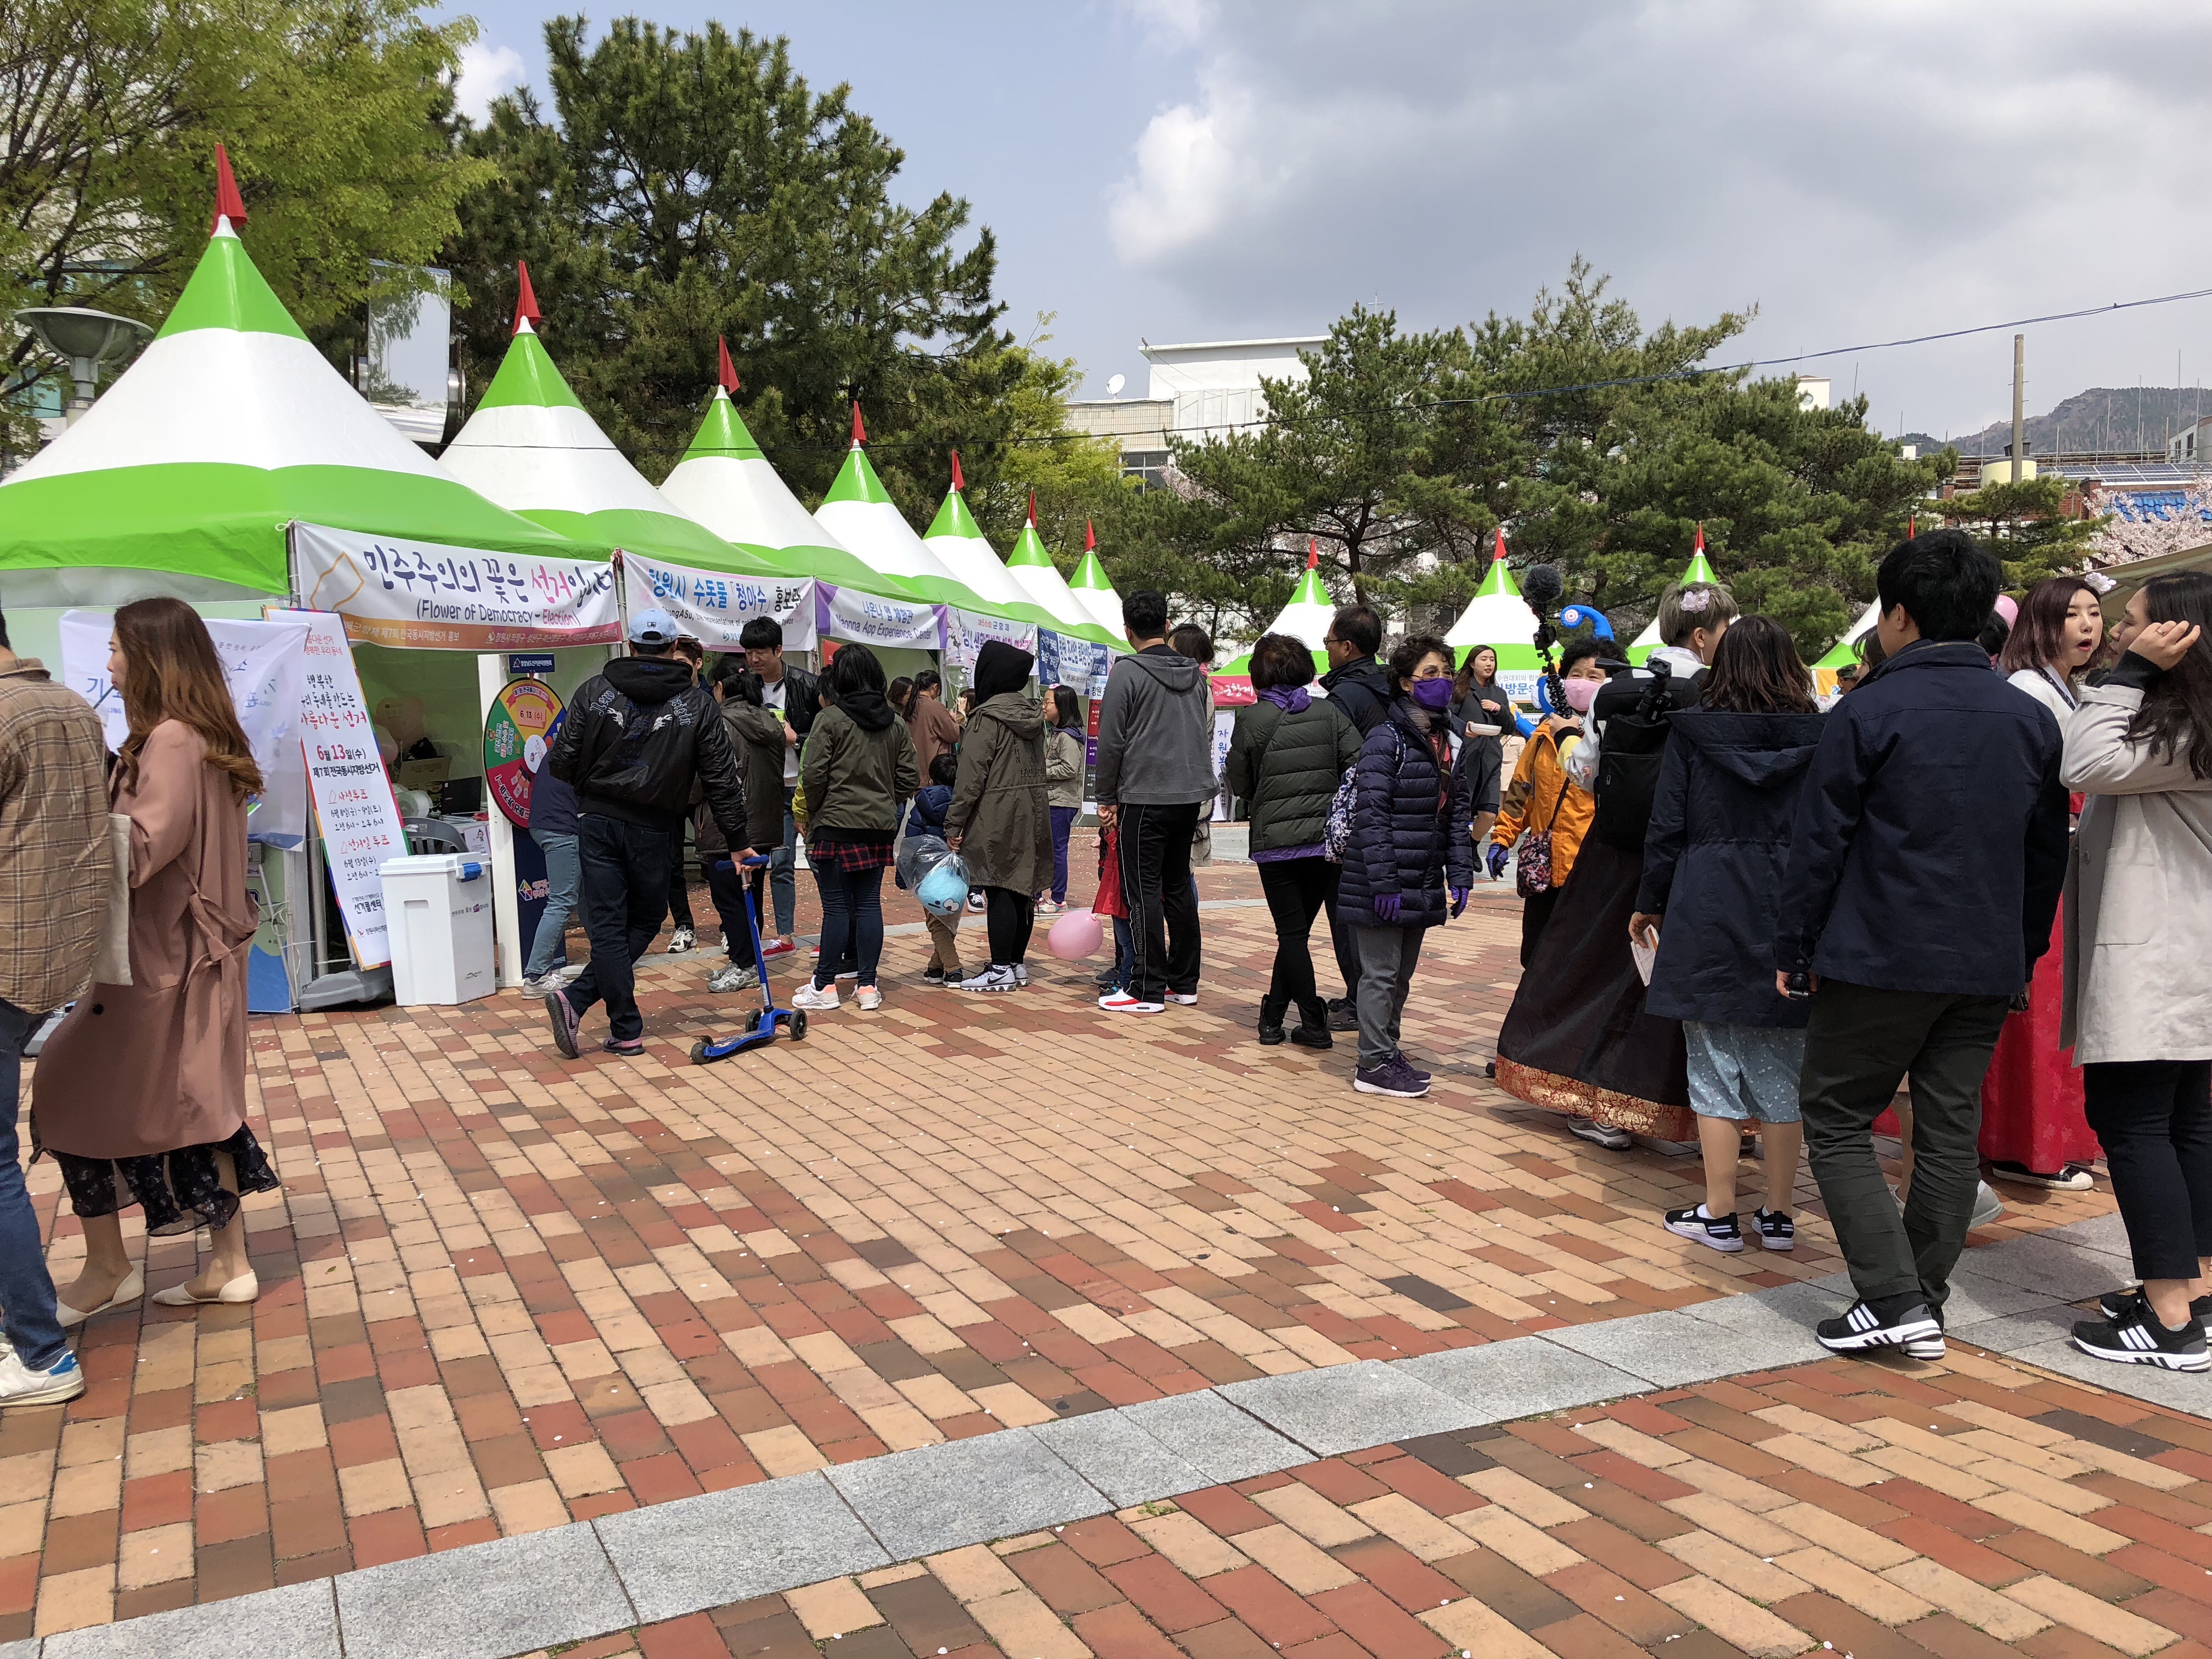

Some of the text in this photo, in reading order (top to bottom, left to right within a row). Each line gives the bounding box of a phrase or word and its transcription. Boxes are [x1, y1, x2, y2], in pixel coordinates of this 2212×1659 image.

[363, 544, 482, 595] 민주주의의
[482, 558, 529, 604] 꽃은
[648, 568, 802, 613] 창원시 수돗물 「청아수」 홍보관
[417, 597, 461, 620] (Flower
[465, 603, 476, 620] of
[479, 603, 533, 627] Democracy
[542, 608, 582, 627] Election)
[862, 601, 913, 624] 나온나 앱 체험관
[836, 614, 932, 640] Naonna App Experience Center
[978, 619, 992, 628] 제56회
[324, 635, 334, 645] 선거
[380, 626, 399, 640] 제7회
[400, 628, 446, 642] 전국동시지방선거
[448, 631, 460, 642] 홍보
[307, 674, 334, 690] 행복한
[1091, 686, 1102, 697] 창원
[589, 690, 616, 717] New
[301, 710, 368, 730] 아름다운 선거
[317, 744, 366, 761] 6월 13일(수)
[335, 822, 346, 831] 오전
[346, 821, 356, 830] 6시
[362, 819, 372, 828] 오후
[373, 817, 384, 826] 6시
[373, 834, 390, 848] 투표
[347, 872, 358, 881] 오전
